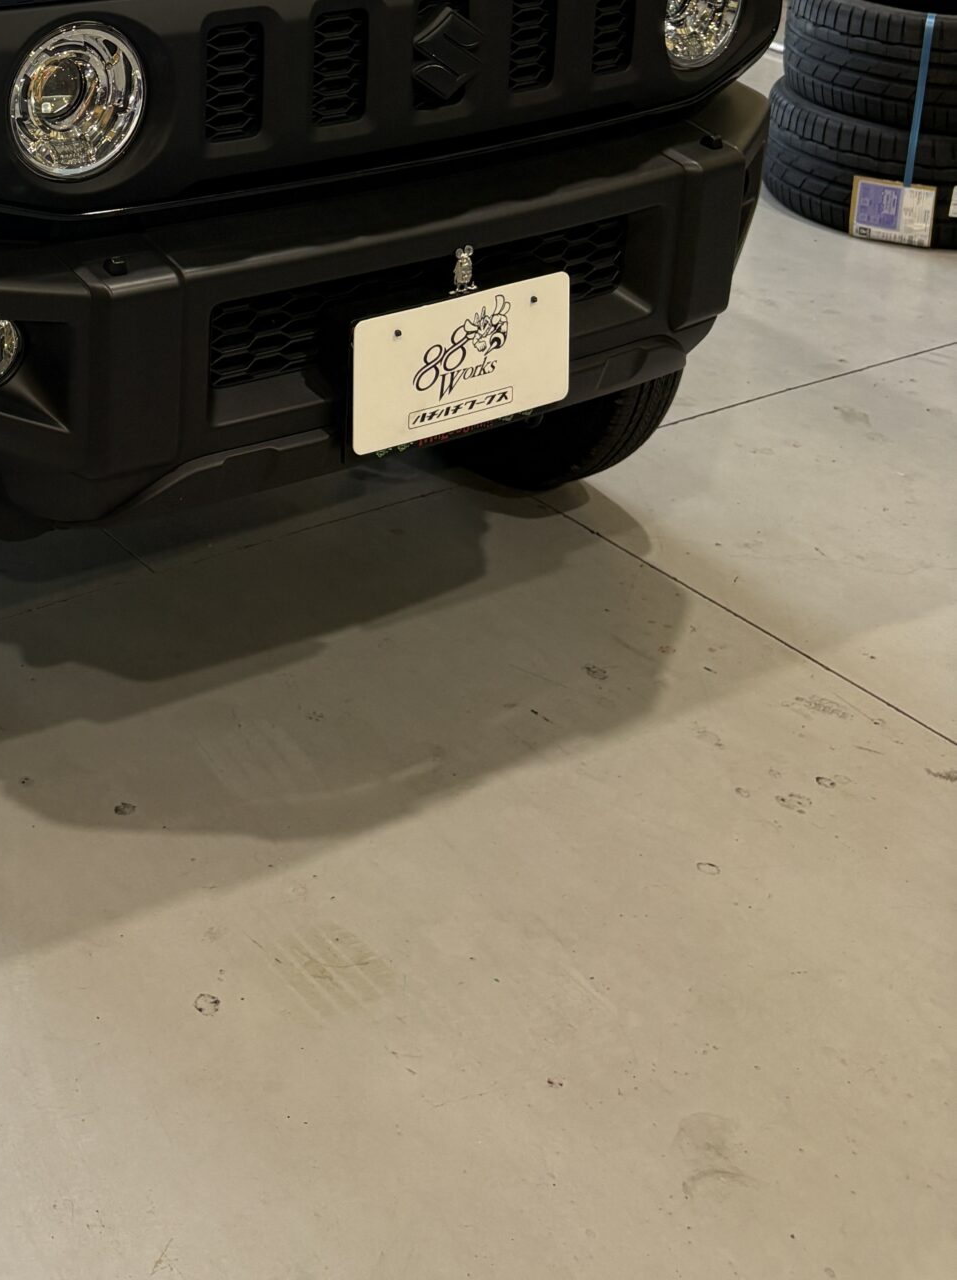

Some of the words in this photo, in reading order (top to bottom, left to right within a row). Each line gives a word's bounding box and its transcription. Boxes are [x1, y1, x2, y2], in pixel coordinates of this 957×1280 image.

[438, 356, 498, 402] Works
[411, 391, 509, 426] ハチハチワークス
